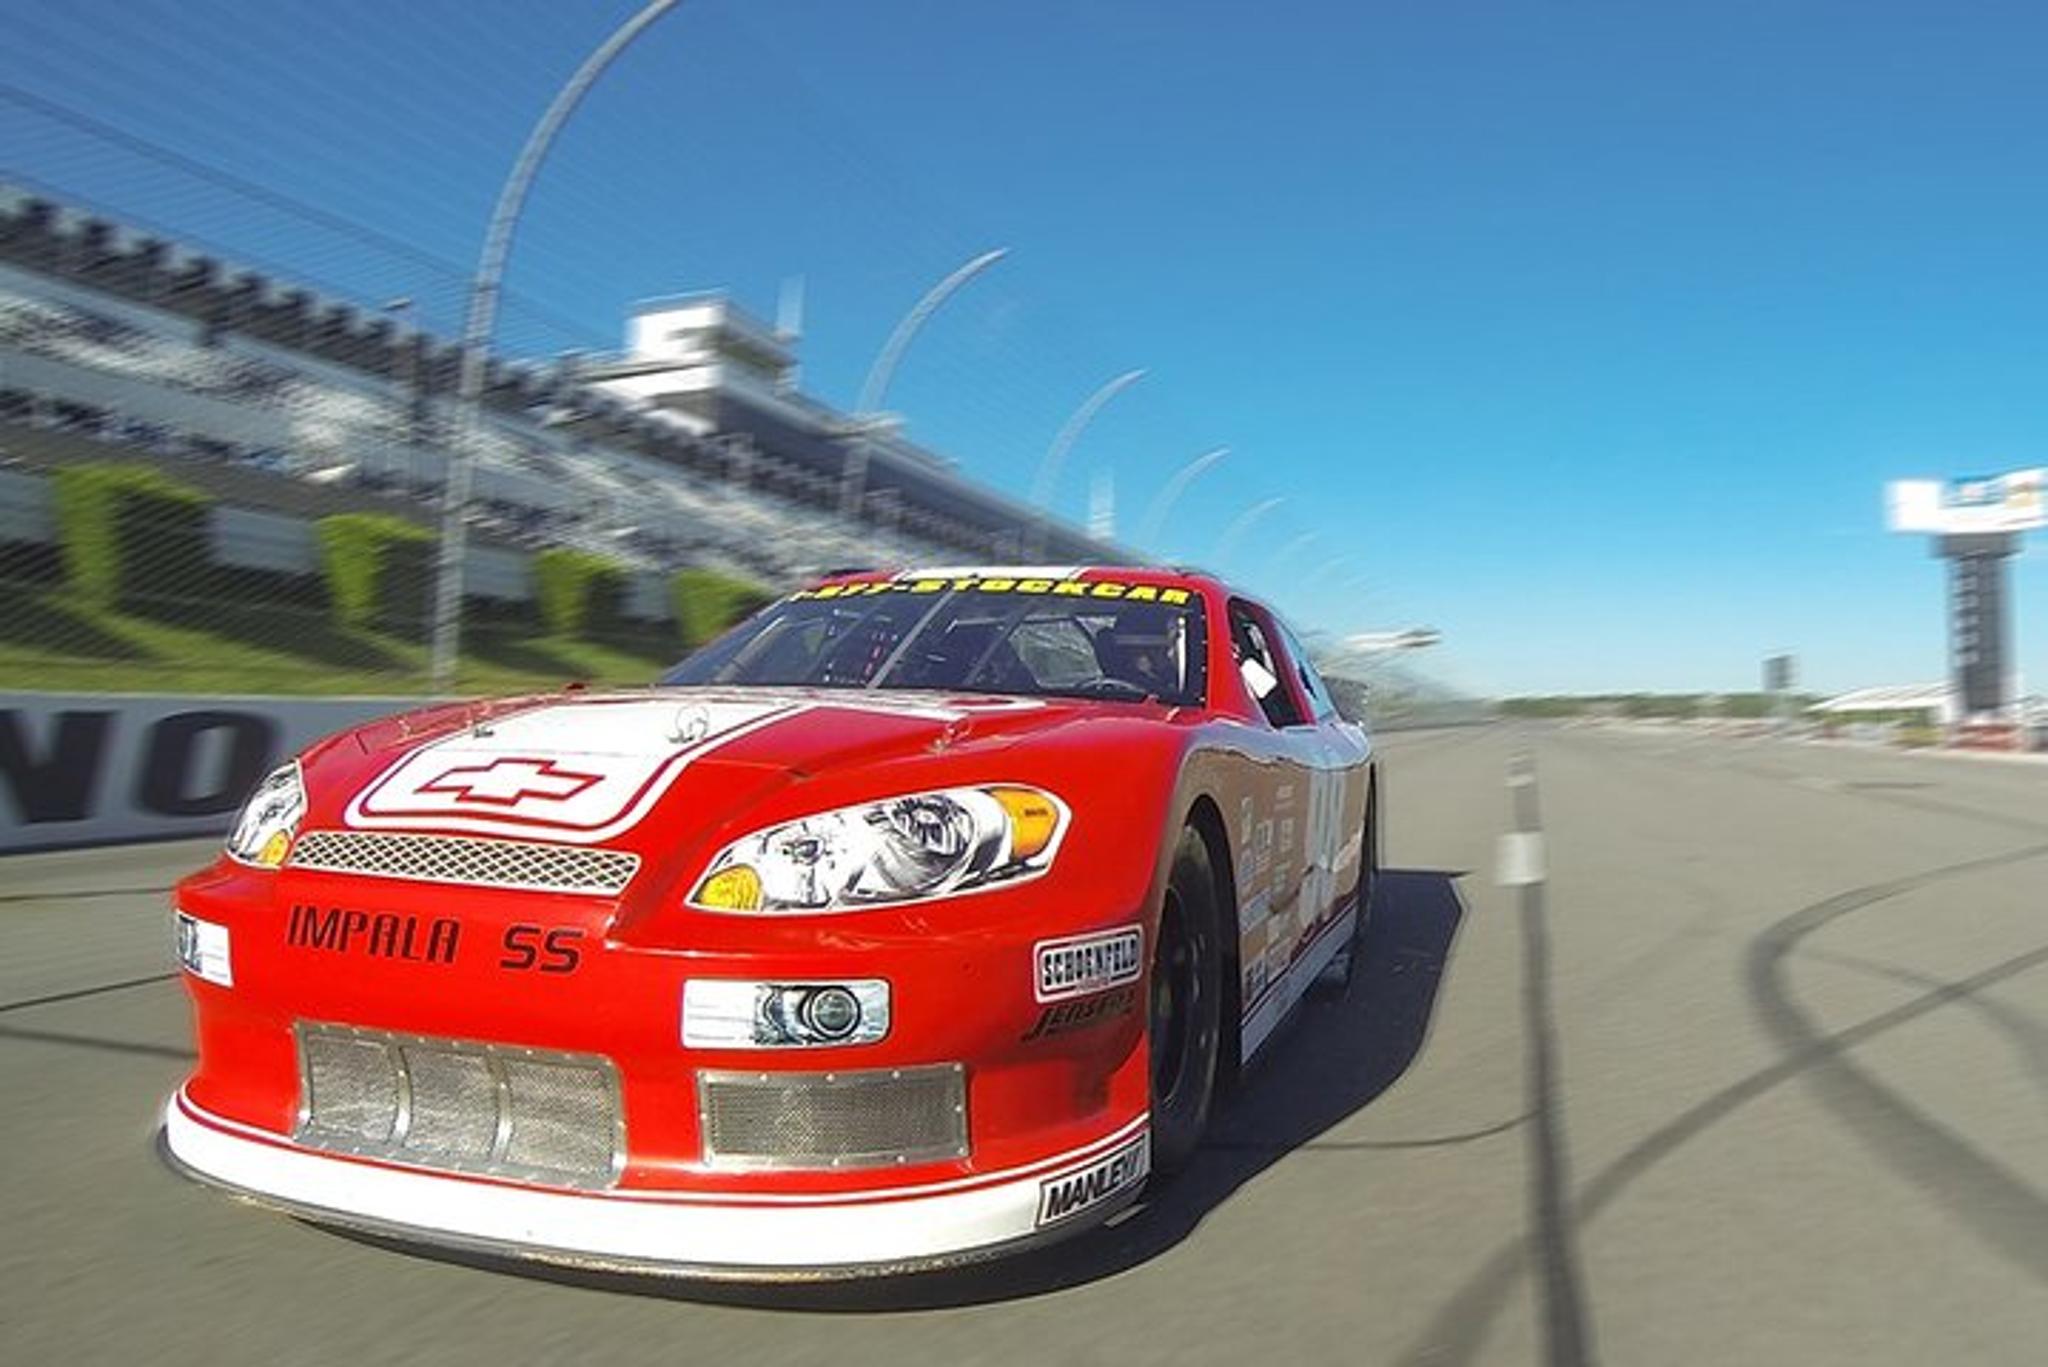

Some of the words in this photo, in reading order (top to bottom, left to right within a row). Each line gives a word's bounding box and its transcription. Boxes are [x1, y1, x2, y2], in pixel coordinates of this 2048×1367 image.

[287, 904, 460, 964] IMPALA
[500, 925, 584, 974] SS
[1044, 938, 1137, 987] SCHOENFELD
